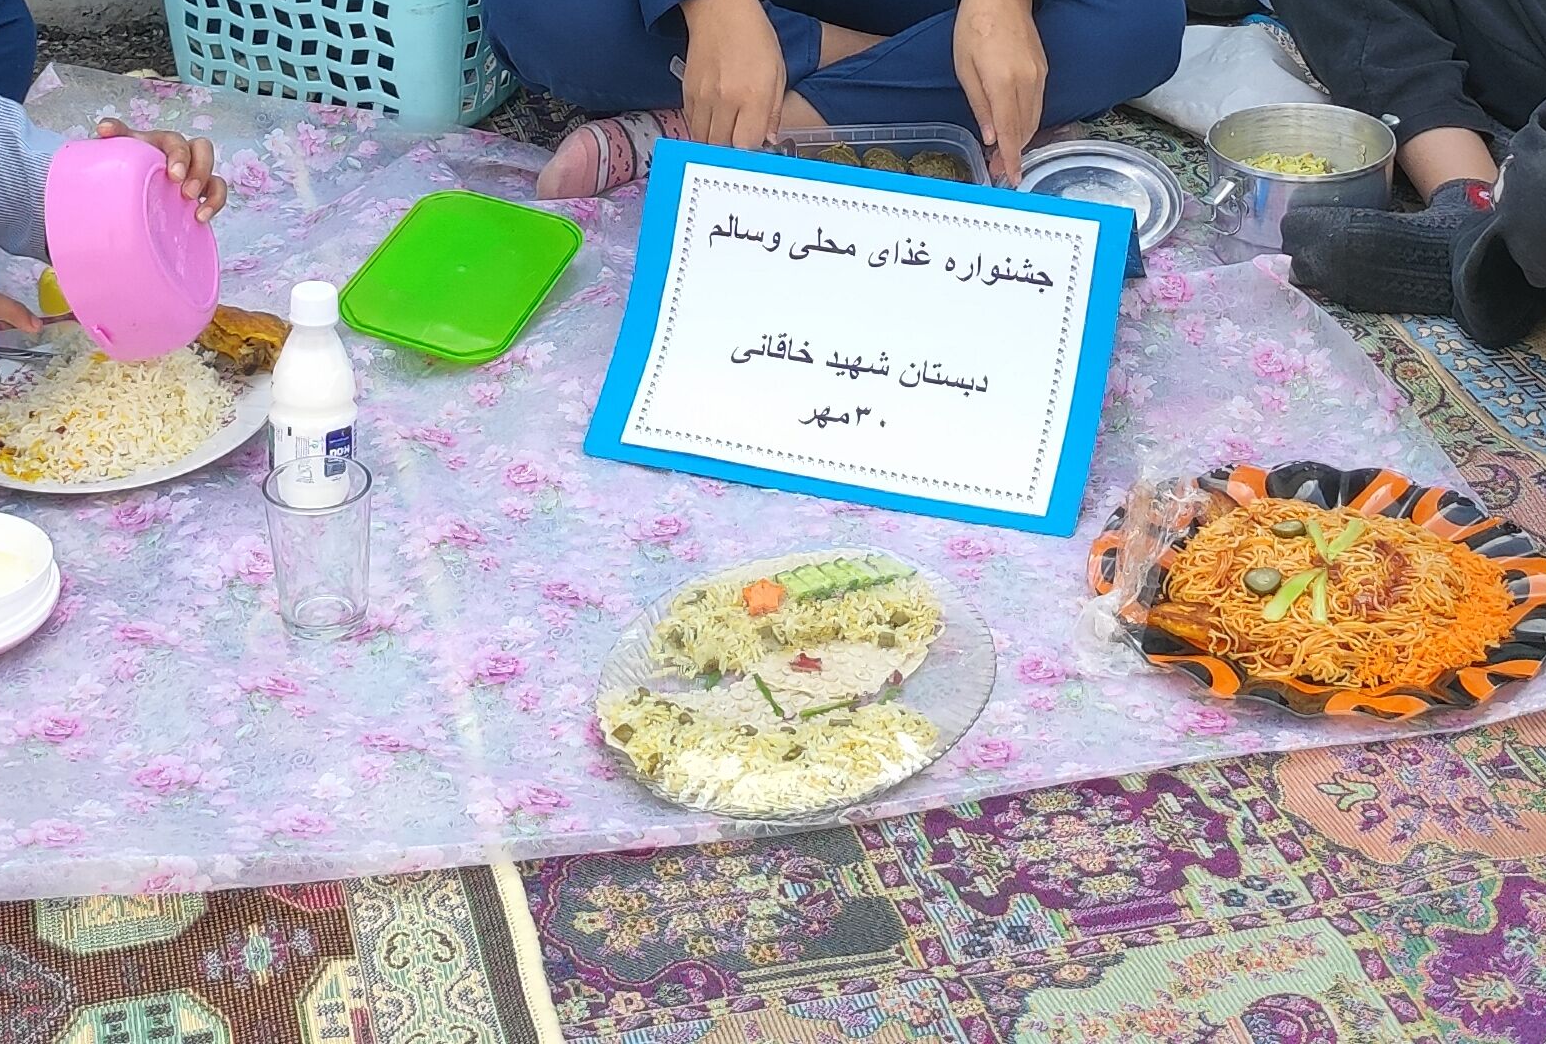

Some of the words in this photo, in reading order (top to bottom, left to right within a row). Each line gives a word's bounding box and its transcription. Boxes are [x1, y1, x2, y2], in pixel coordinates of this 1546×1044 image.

[788, 226, 857, 261] محلی
[867, 237, 932, 268] غذای
[944, 253, 1055, 293] جشنواره
[730, 332, 814, 364] خاقانی
[825, 351, 890, 380] شهید
[899, 360, 988, 397] دبستان
